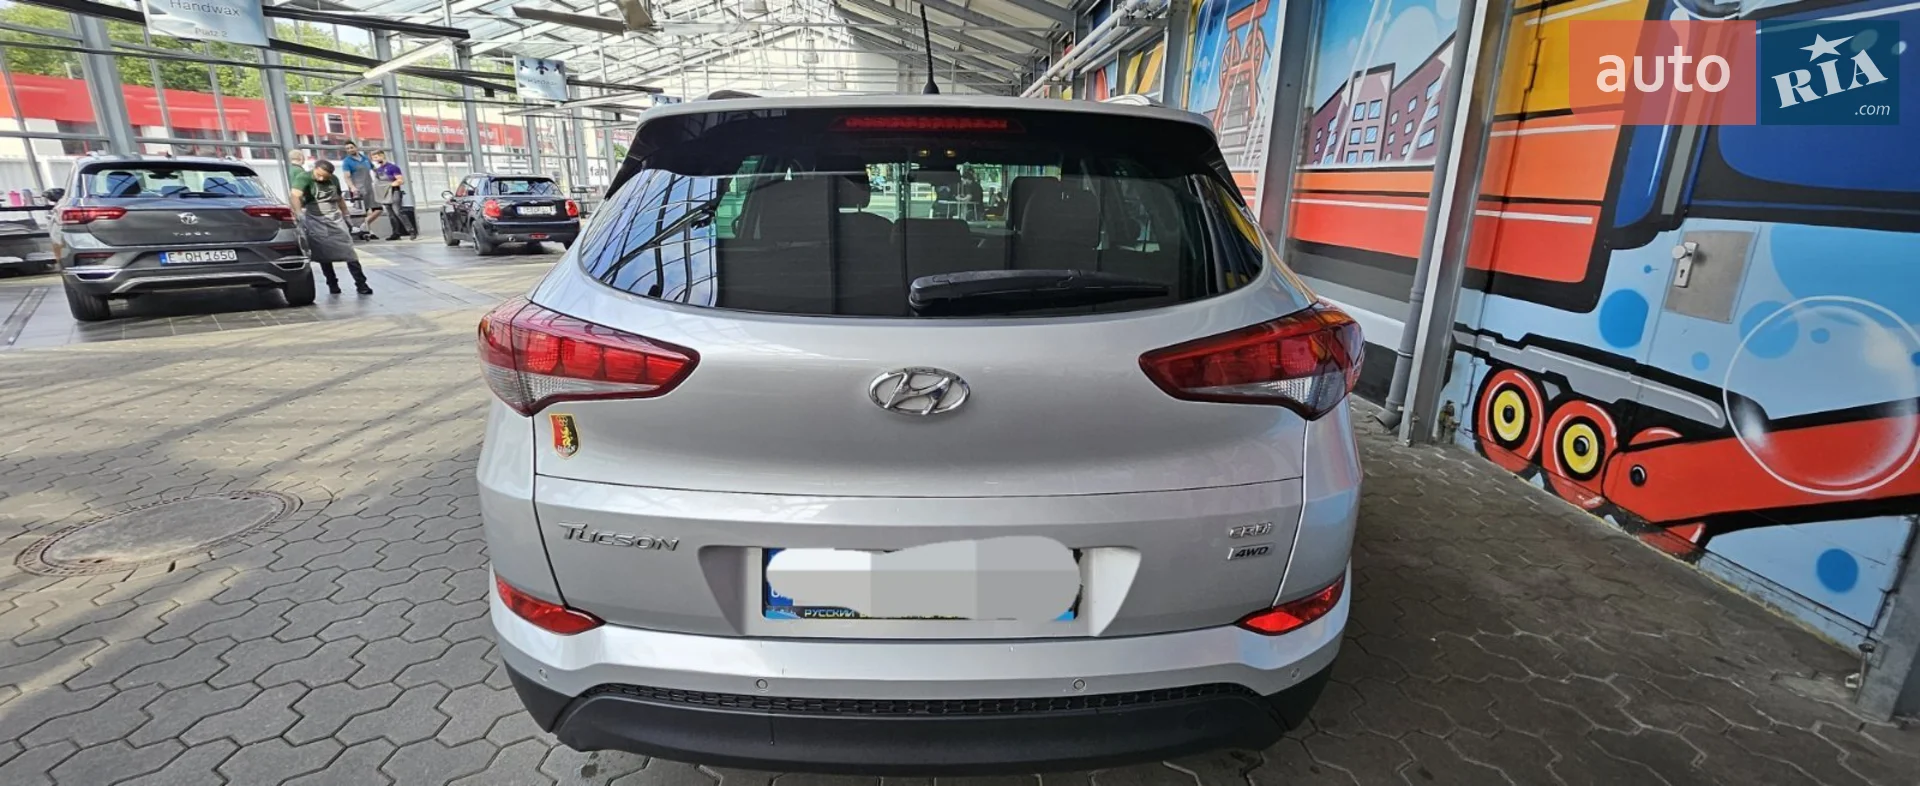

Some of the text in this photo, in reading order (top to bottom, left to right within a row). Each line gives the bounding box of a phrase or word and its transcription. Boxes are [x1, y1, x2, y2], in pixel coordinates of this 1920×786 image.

[170, 0, 240, 16] Handwax
[221, 30, 228, 38] 2
[557, 522, 679, 552] TUCSON
[1235, 546, 1268, 558] 4WD
